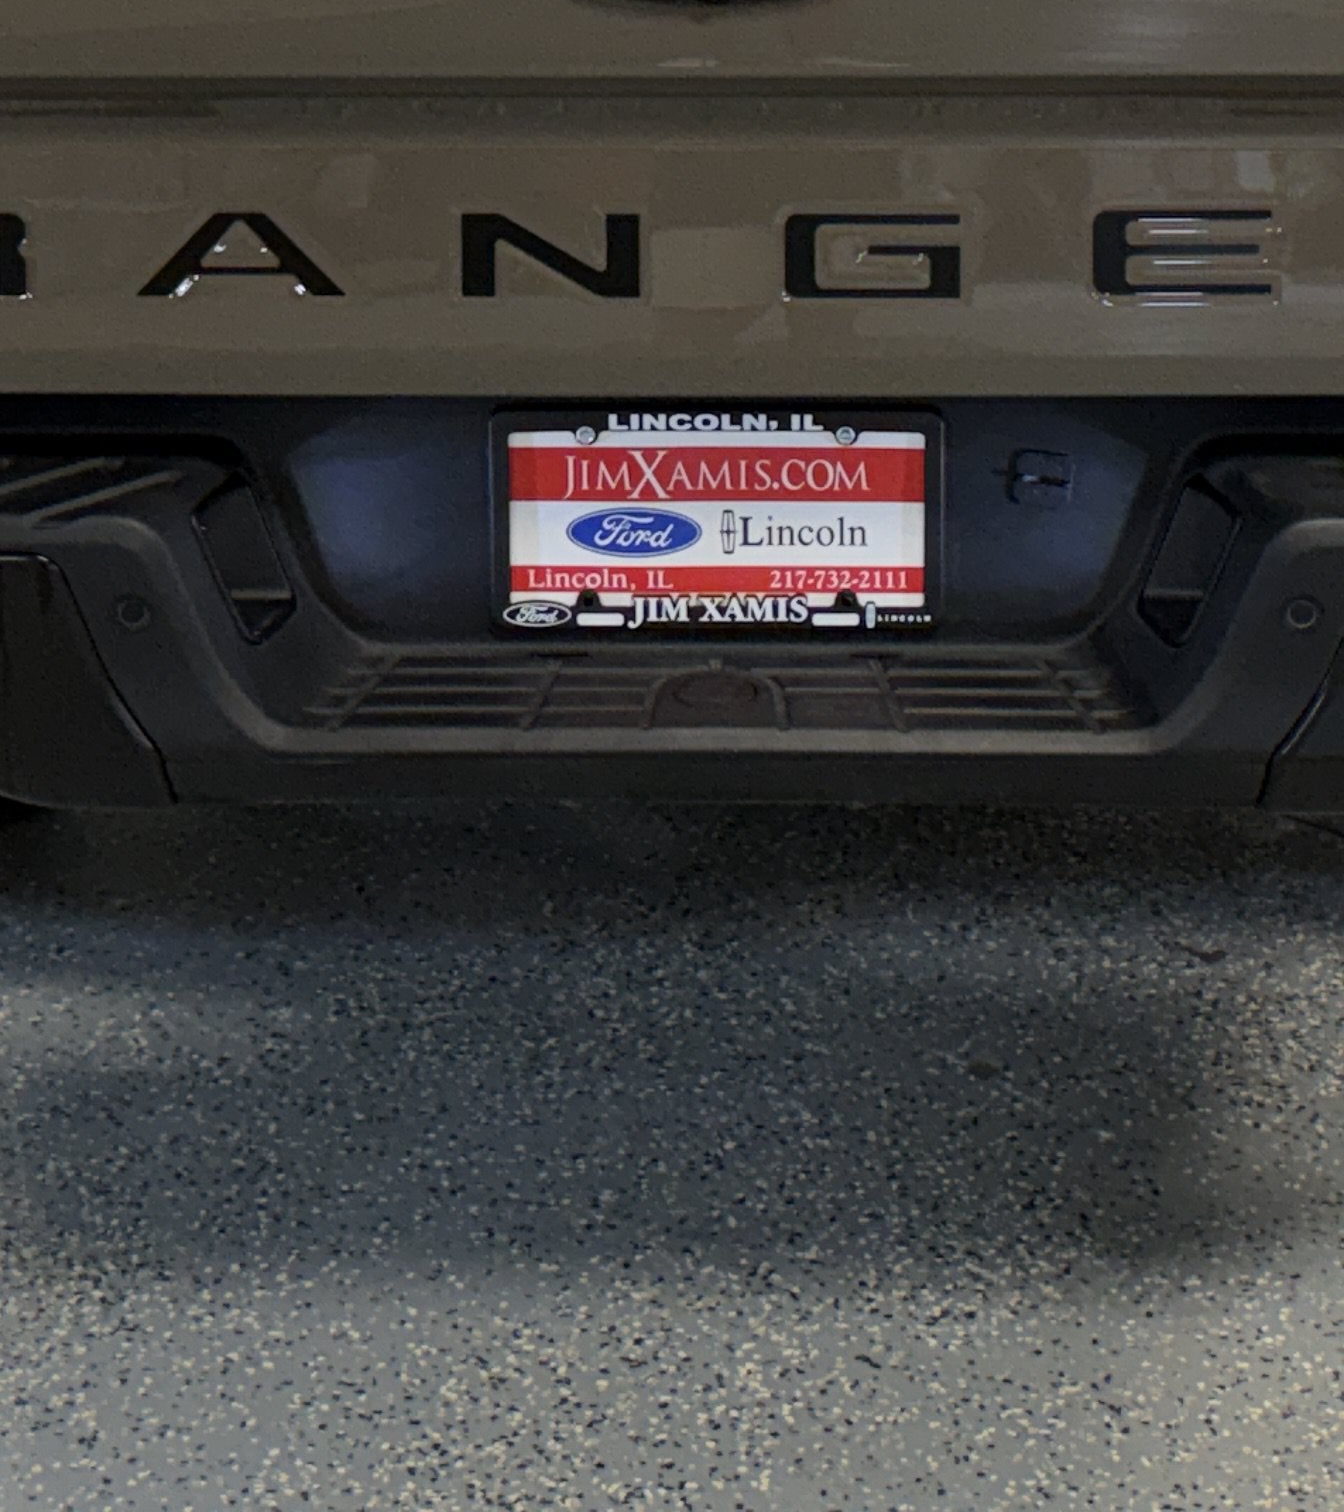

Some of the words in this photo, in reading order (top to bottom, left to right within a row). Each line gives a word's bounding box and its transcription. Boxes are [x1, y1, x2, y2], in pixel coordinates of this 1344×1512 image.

[608, 413, 778, 431] LINCOLN,
[790, 414, 824, 431] IL
[593, 514, 674, 549] Ford
[739, 515, 868, 547] Lincoln
[527, 569, 636, 590] Lincoln,
[647, 570, 674, 588] IL
[770, 570, 907, 588] 217-732-2111
[516, 604, 558, 623] Ford
[627, 596, 690, 629] JIM
[698, 596, 809, 623] XAMIS
